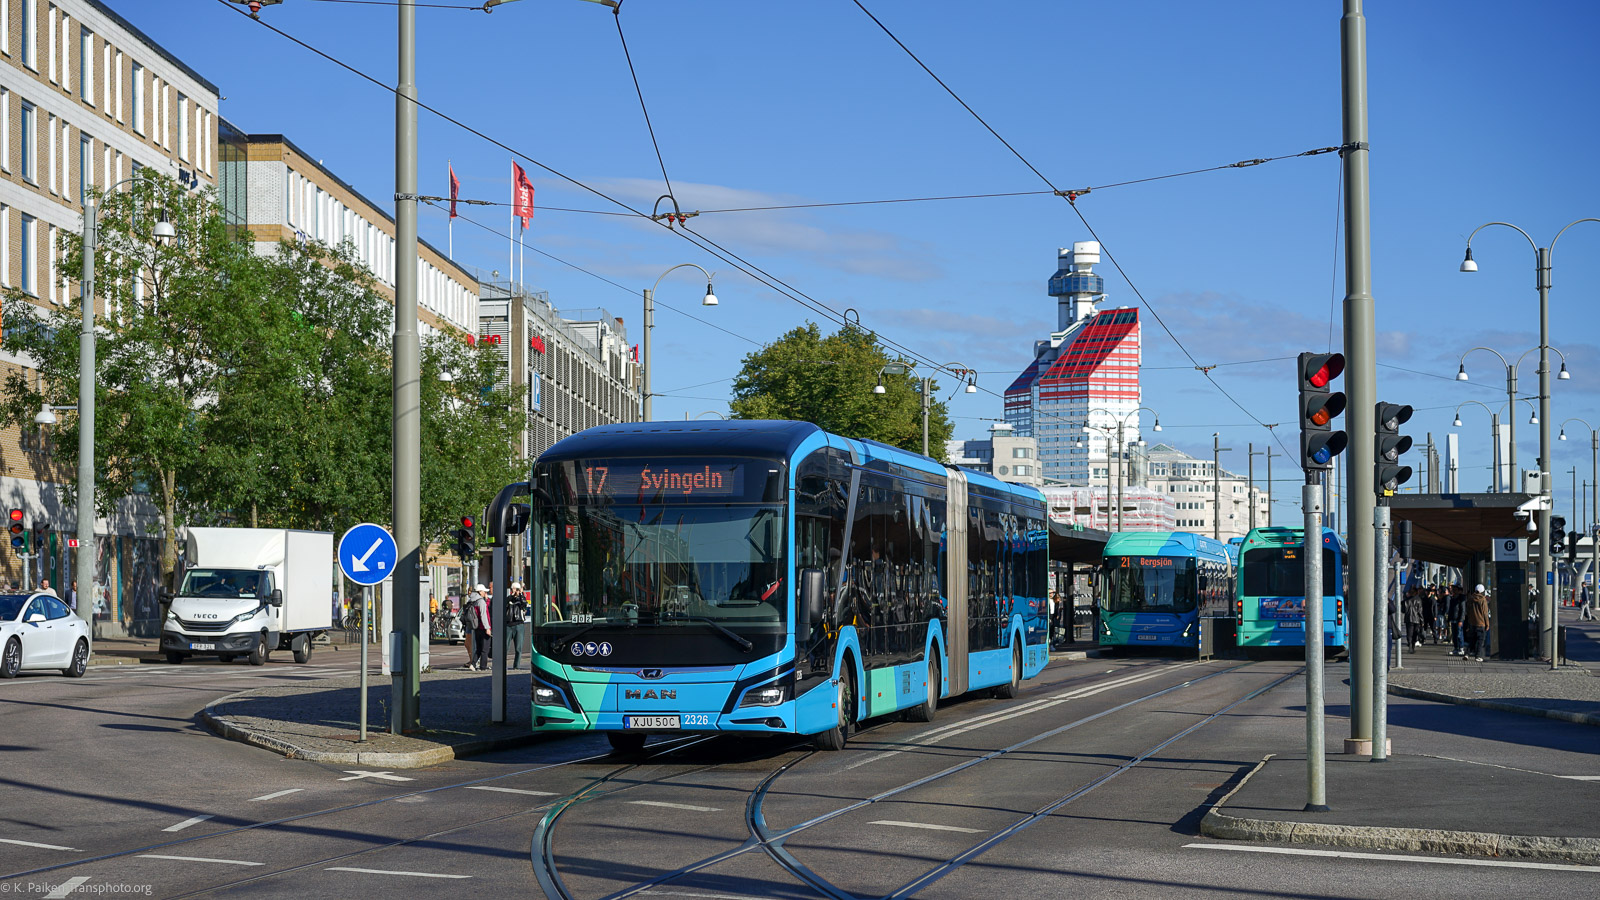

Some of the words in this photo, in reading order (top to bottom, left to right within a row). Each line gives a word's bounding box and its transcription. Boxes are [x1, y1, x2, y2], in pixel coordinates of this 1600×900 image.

[586, 467, 608, 494] 17
[641, 465, 722, 494] Svingeln
[1121, 556, 1130, 568] 21
[1140, 557, 1172, 568] Bergsjön
[572, 615, 591, 623] 402
[625, 689, 677, 700] MAN
[633, 717, 653, 727] XJU
[684, 715, 709, 725] 2326
